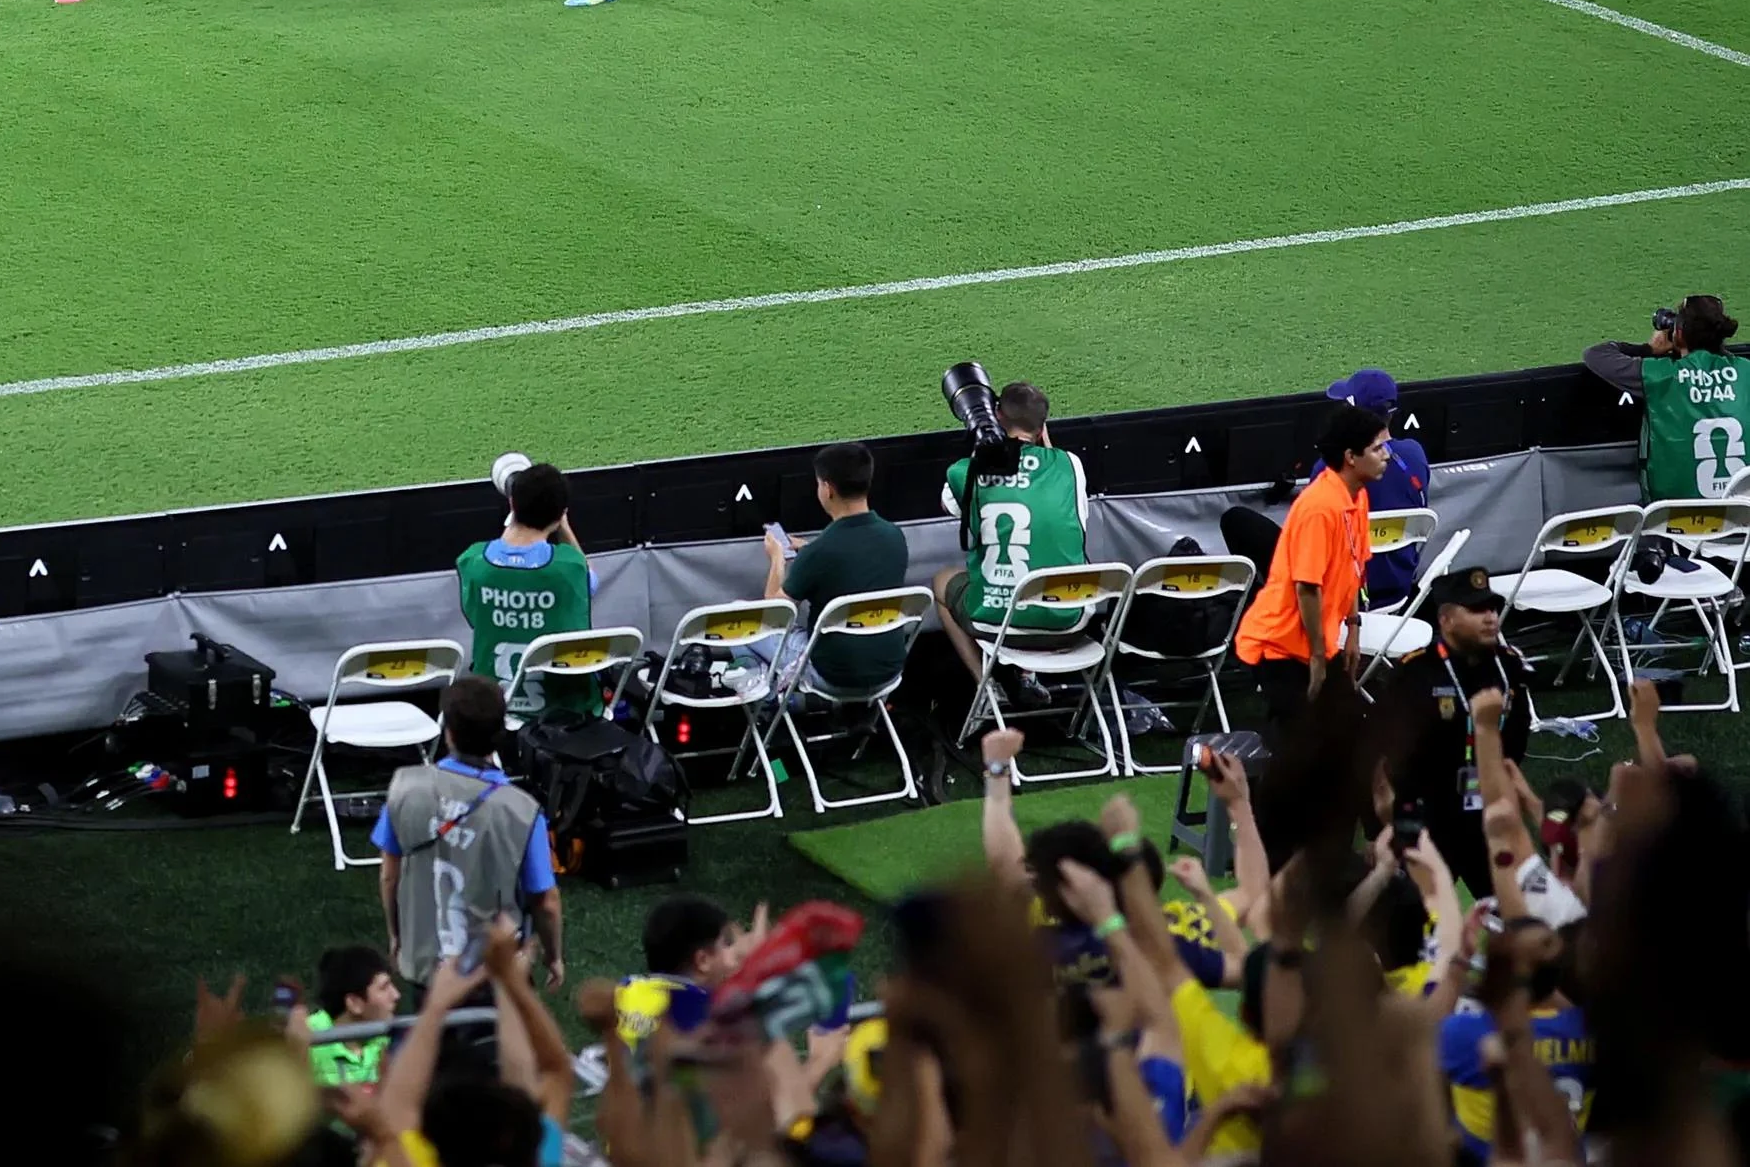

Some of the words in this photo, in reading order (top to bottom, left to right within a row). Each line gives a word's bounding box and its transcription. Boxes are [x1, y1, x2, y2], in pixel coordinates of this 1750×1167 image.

[1677, 366, 1738, 387] PHOTO
[1689, 384, 1736, 403] 0744
[1373, 526, 1387, 537] 16
[994, 569, 1015, 578] FIFA
[481, 586, 555, 609] PHOTO
[492, 609, 545, 629] 0618
